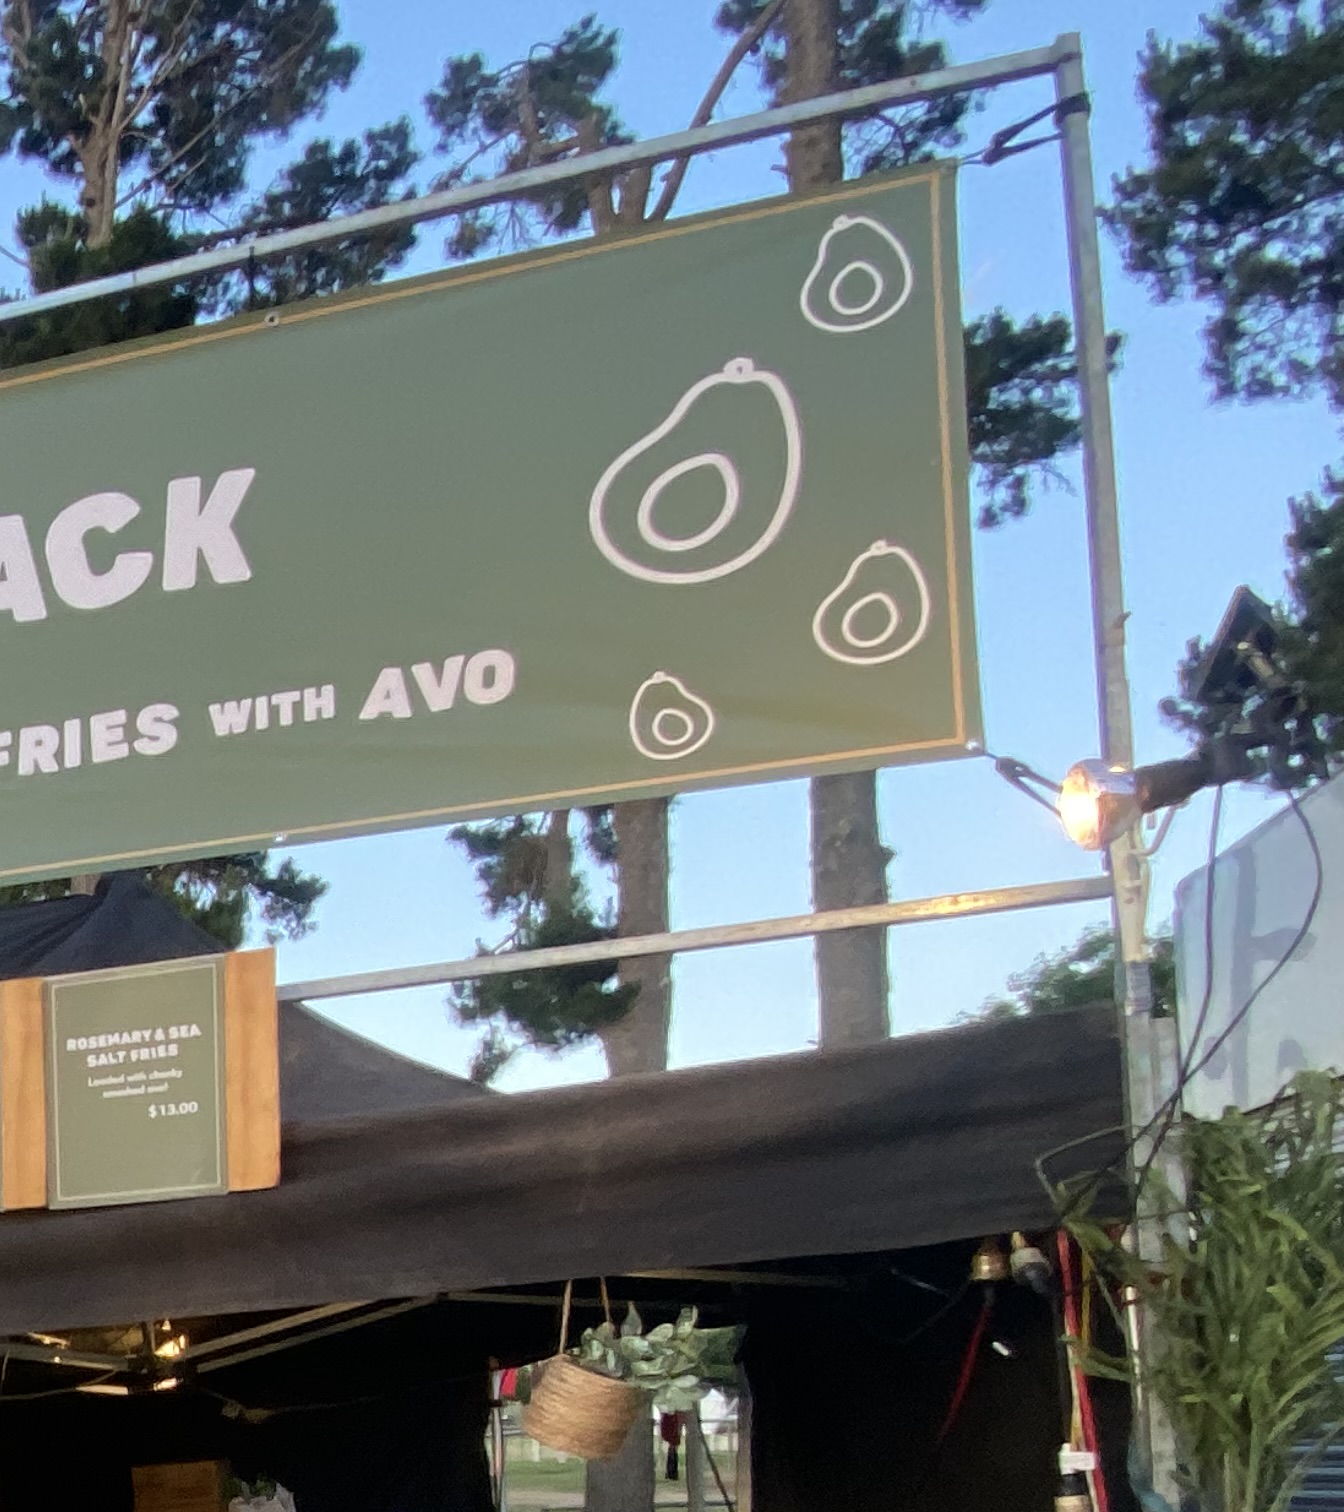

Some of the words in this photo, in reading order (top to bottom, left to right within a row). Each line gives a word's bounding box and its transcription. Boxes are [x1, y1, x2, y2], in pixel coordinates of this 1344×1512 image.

[207, 682, 337, 738] WITH
[358, 648, 517, 721] AVO
[66, 1028, 152, 1052] ROSEMARY
[168, 1023, 202, 1039] SEA
[86, 1050, 126, 1068] SALT
[130, 1043, 179, 1063] FRIES
[148, 1101, 199, 1119] $13.00
